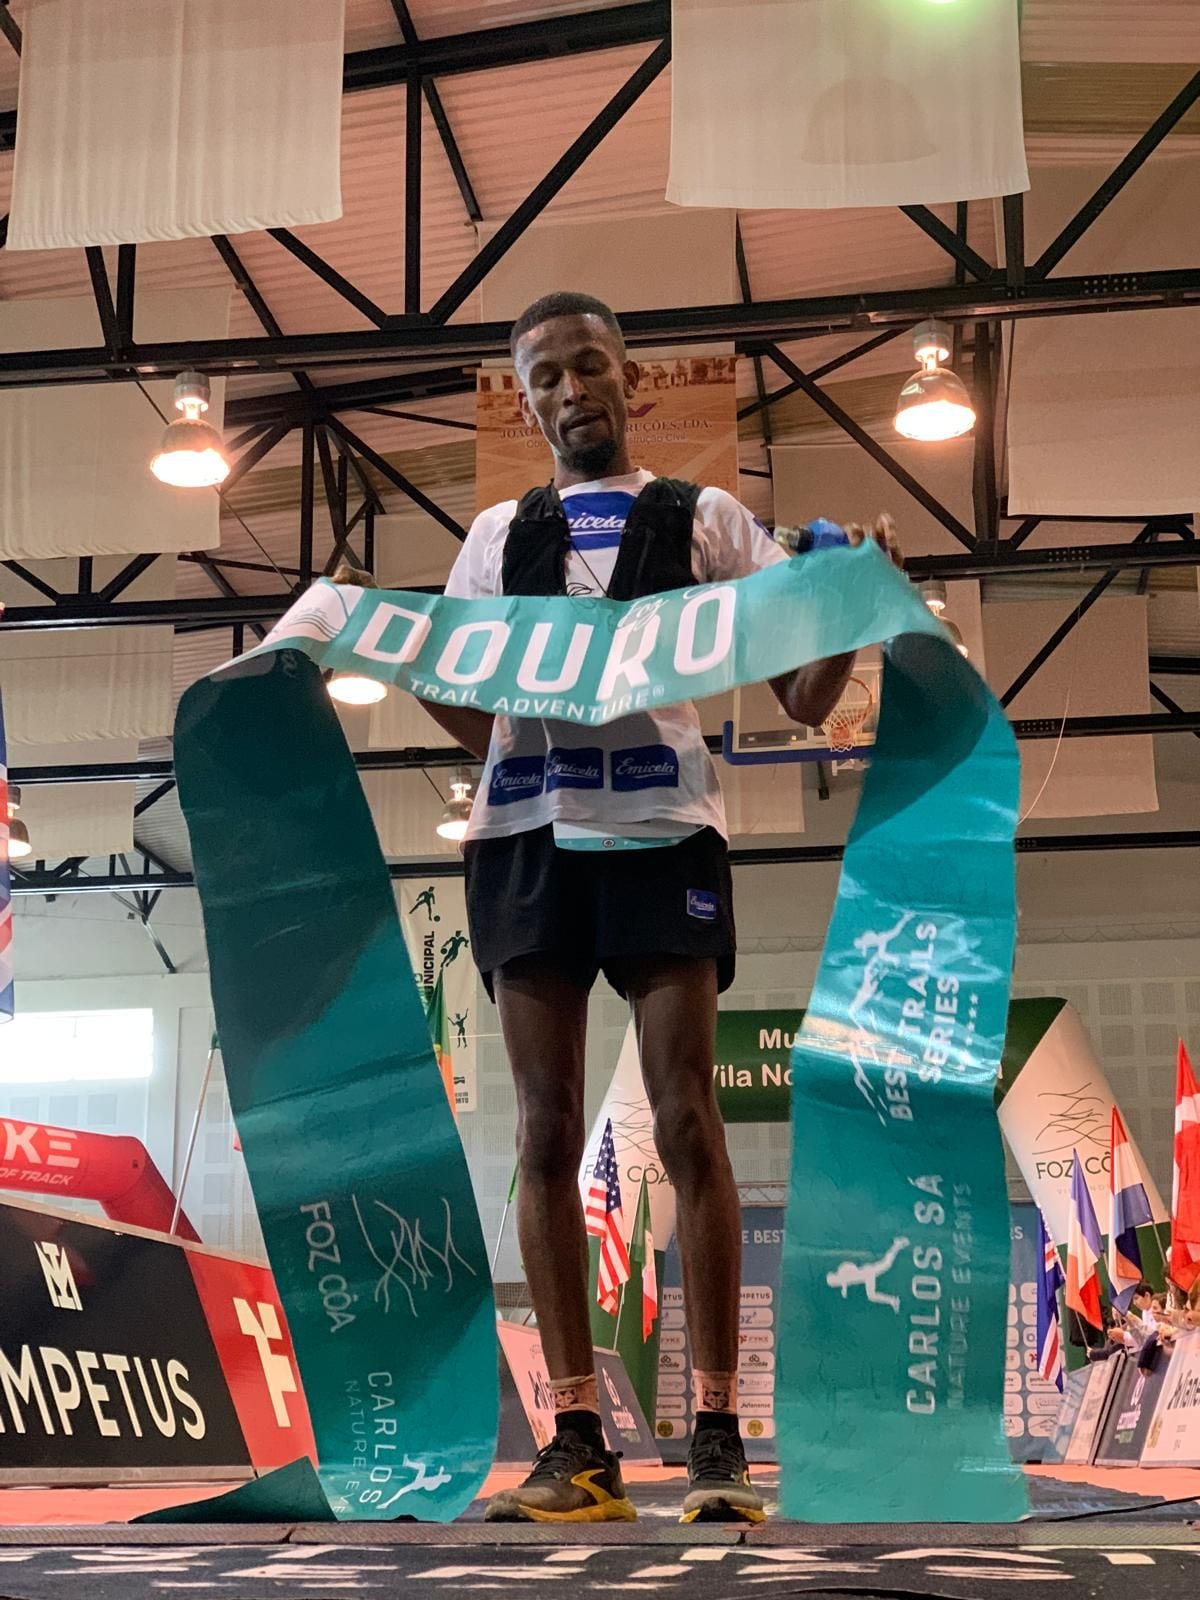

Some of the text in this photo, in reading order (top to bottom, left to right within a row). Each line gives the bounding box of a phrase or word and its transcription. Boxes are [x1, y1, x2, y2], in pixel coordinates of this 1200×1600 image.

[351, 585, 738, 702] DOURO
[410, 678, 482, 706] TRAIL
[898, 921, 938, 1036] TRAILS
[918, 974, 960, 1084] SERIES
[19, 1169, 75, 1185] TRACK
[907, 1174, 945, 1226] SÁ
[1036, 1159, 1074, 1179] FOZ
[300, 1200, 341, 1272] FOZ
[906, 1246, 943, 1415] CARLOS
[0, 1343, 207, 1440] MPETUS
[345, 1379, 368, 1469] NATURE
[359, 1371, 398, 1504] CARLOS
